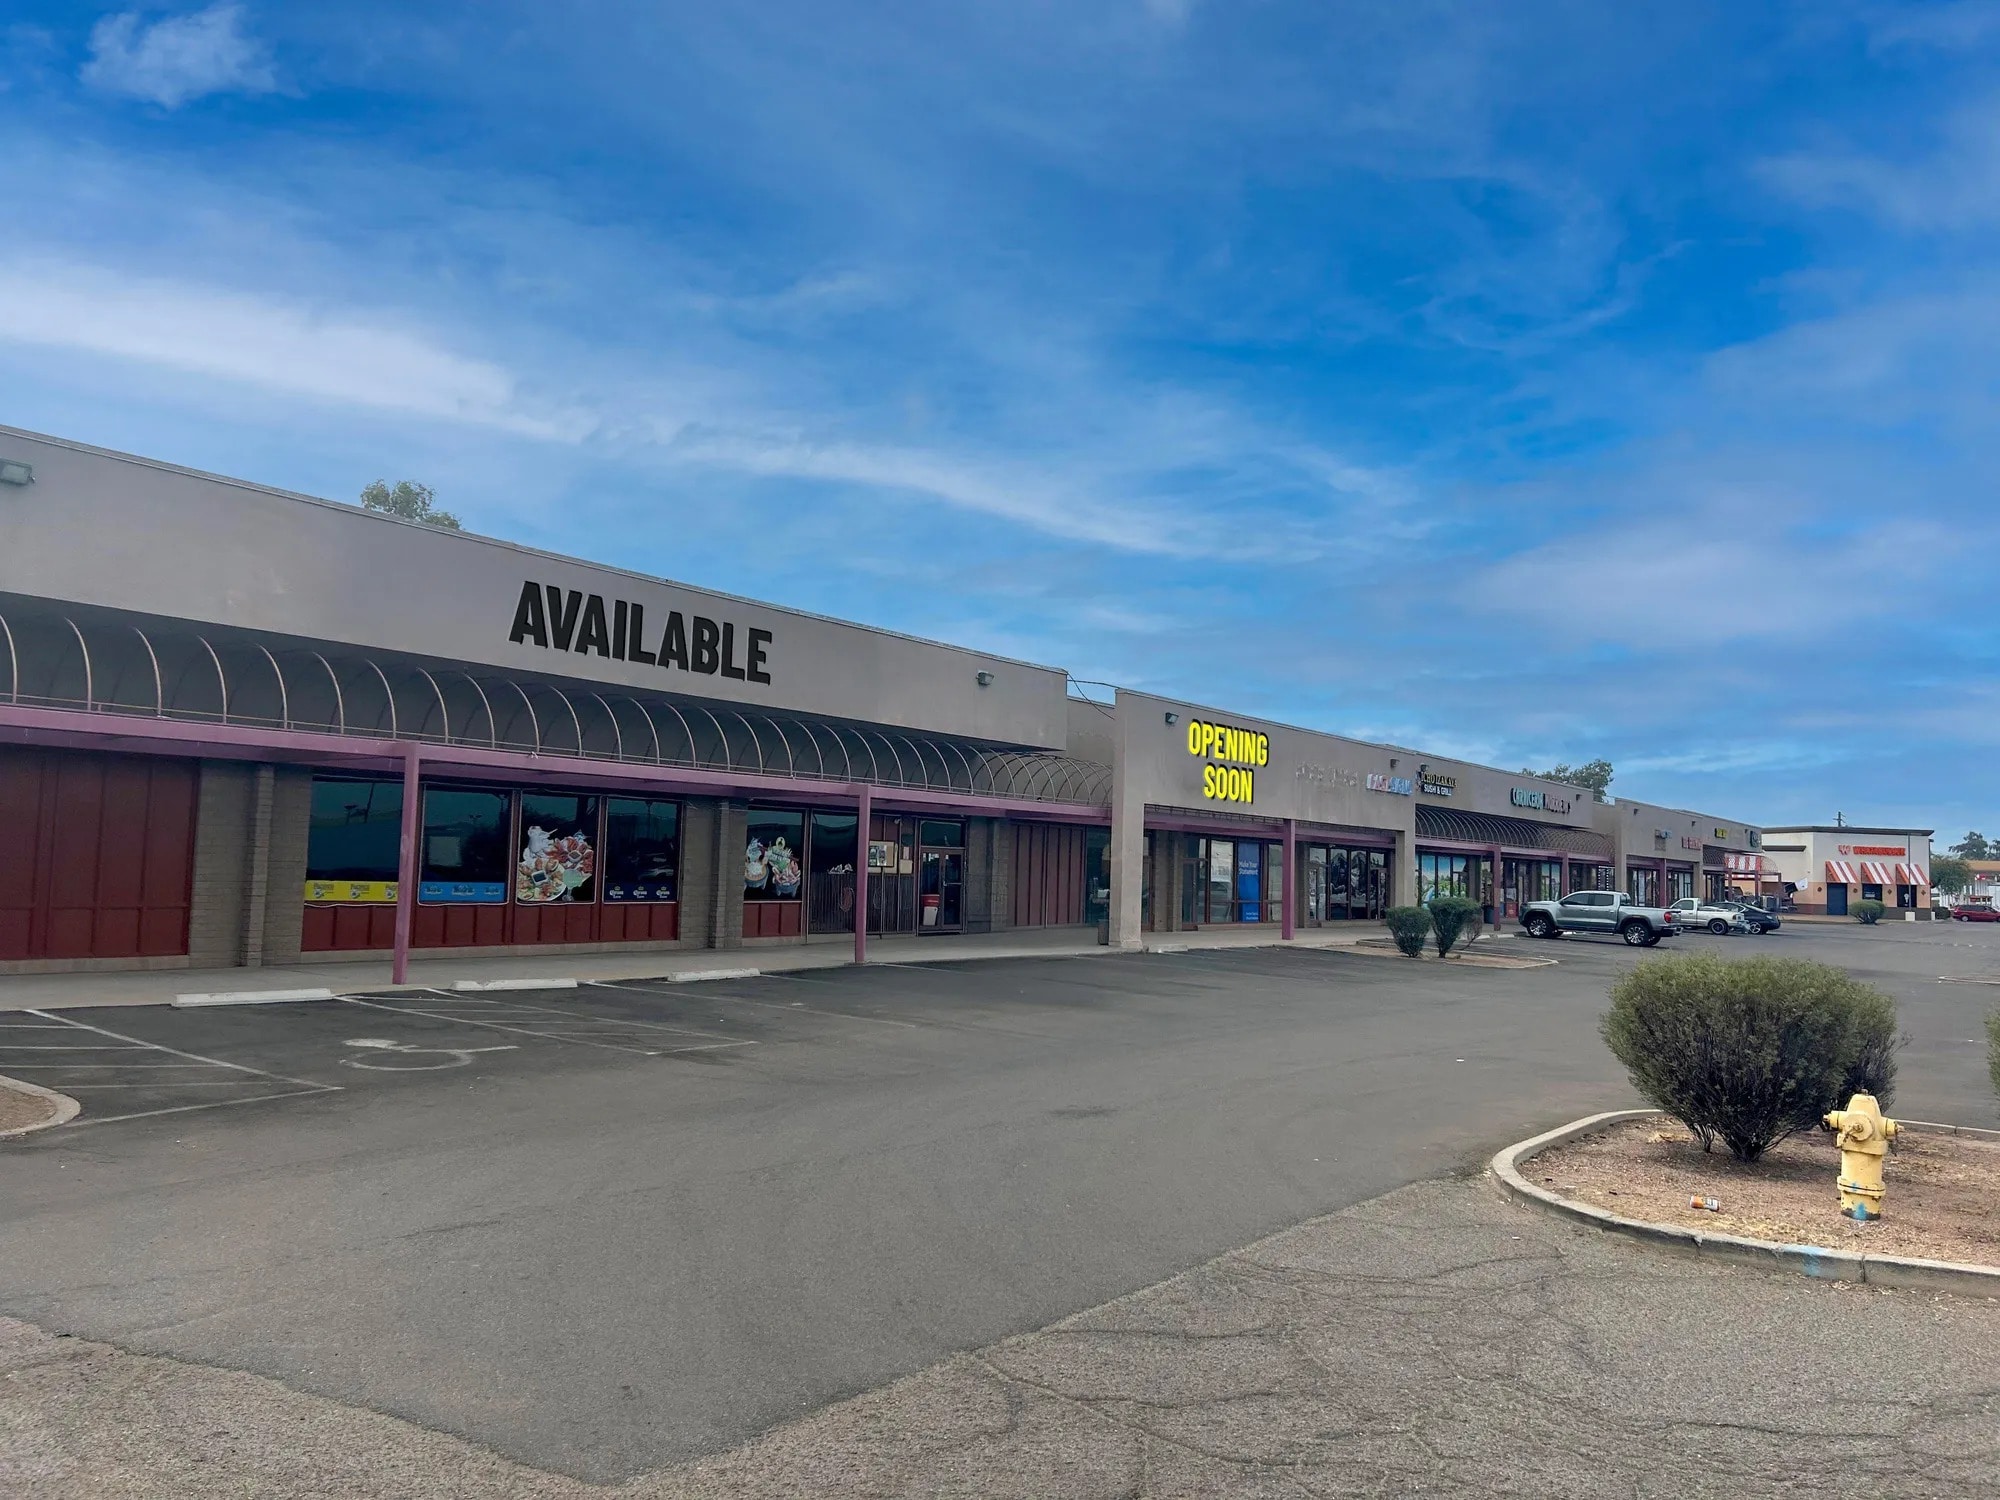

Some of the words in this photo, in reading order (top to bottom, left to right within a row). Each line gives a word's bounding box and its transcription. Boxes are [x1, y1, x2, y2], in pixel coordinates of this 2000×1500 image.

[509, 580, 772, 685] AVAILABLE
[1188, 719, 1269, 767] OPENING
[1203, 762, 1254, 804] SOON
